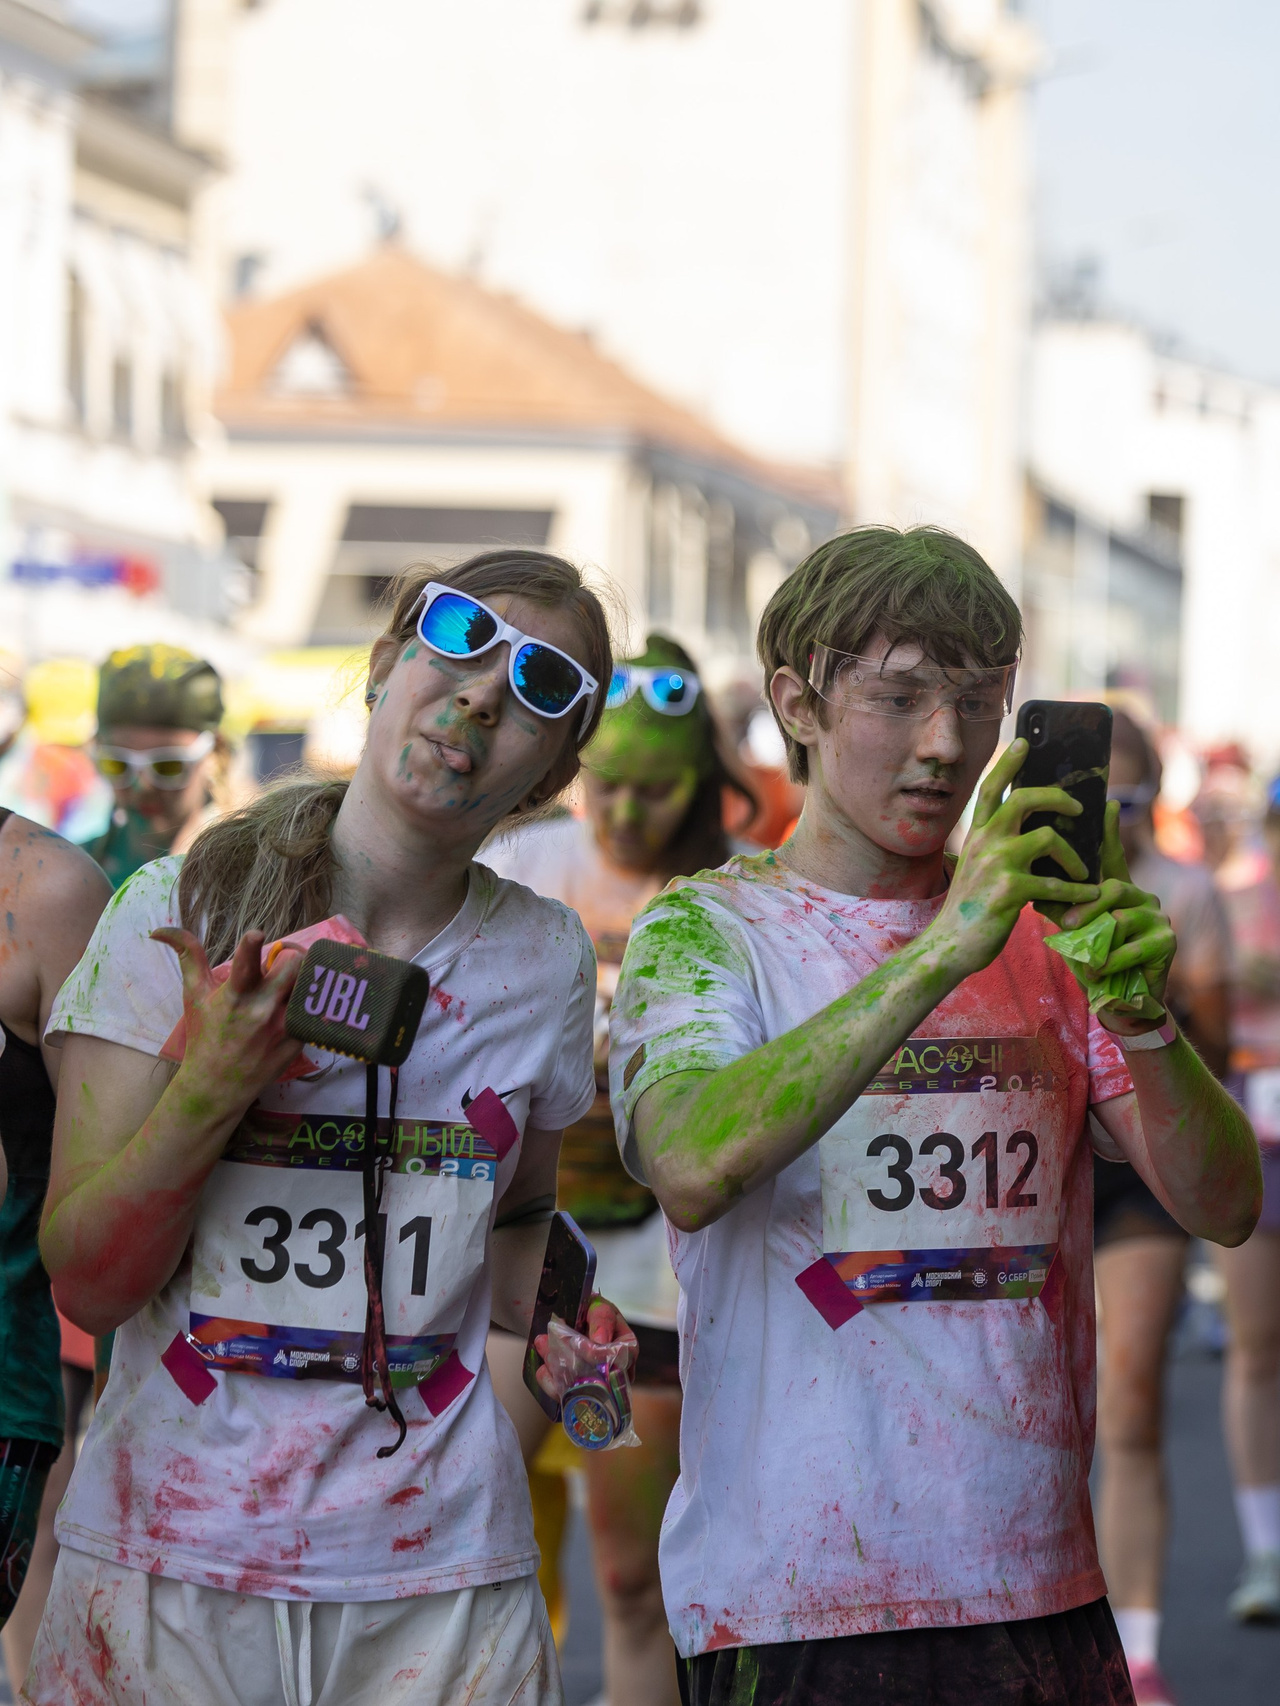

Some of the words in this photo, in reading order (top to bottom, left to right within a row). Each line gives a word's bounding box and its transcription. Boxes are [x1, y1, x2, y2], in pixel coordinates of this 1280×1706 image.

[304, 966, 370, 1031] JBL
[870, 1079, 965, 1091] АБЕГ
[978, 1074, 1057, 1093] 202
[866, 1130, 1039, 1213] 3312
[239, 1205, 432, 1296] 3311
[925, 1270, 962, 1280] МОСКОВСКИЙ
[1008, 1272, 1028, 1282] СБЕР
[925, 1279, 943, 1288] СПОРТ
[290, 1350, 331, 1362] МОСКОВСКИЙ
[289, 1357, 309, 1369] СПОРТ
[388, 1362, 413, 1373] СБЕР
